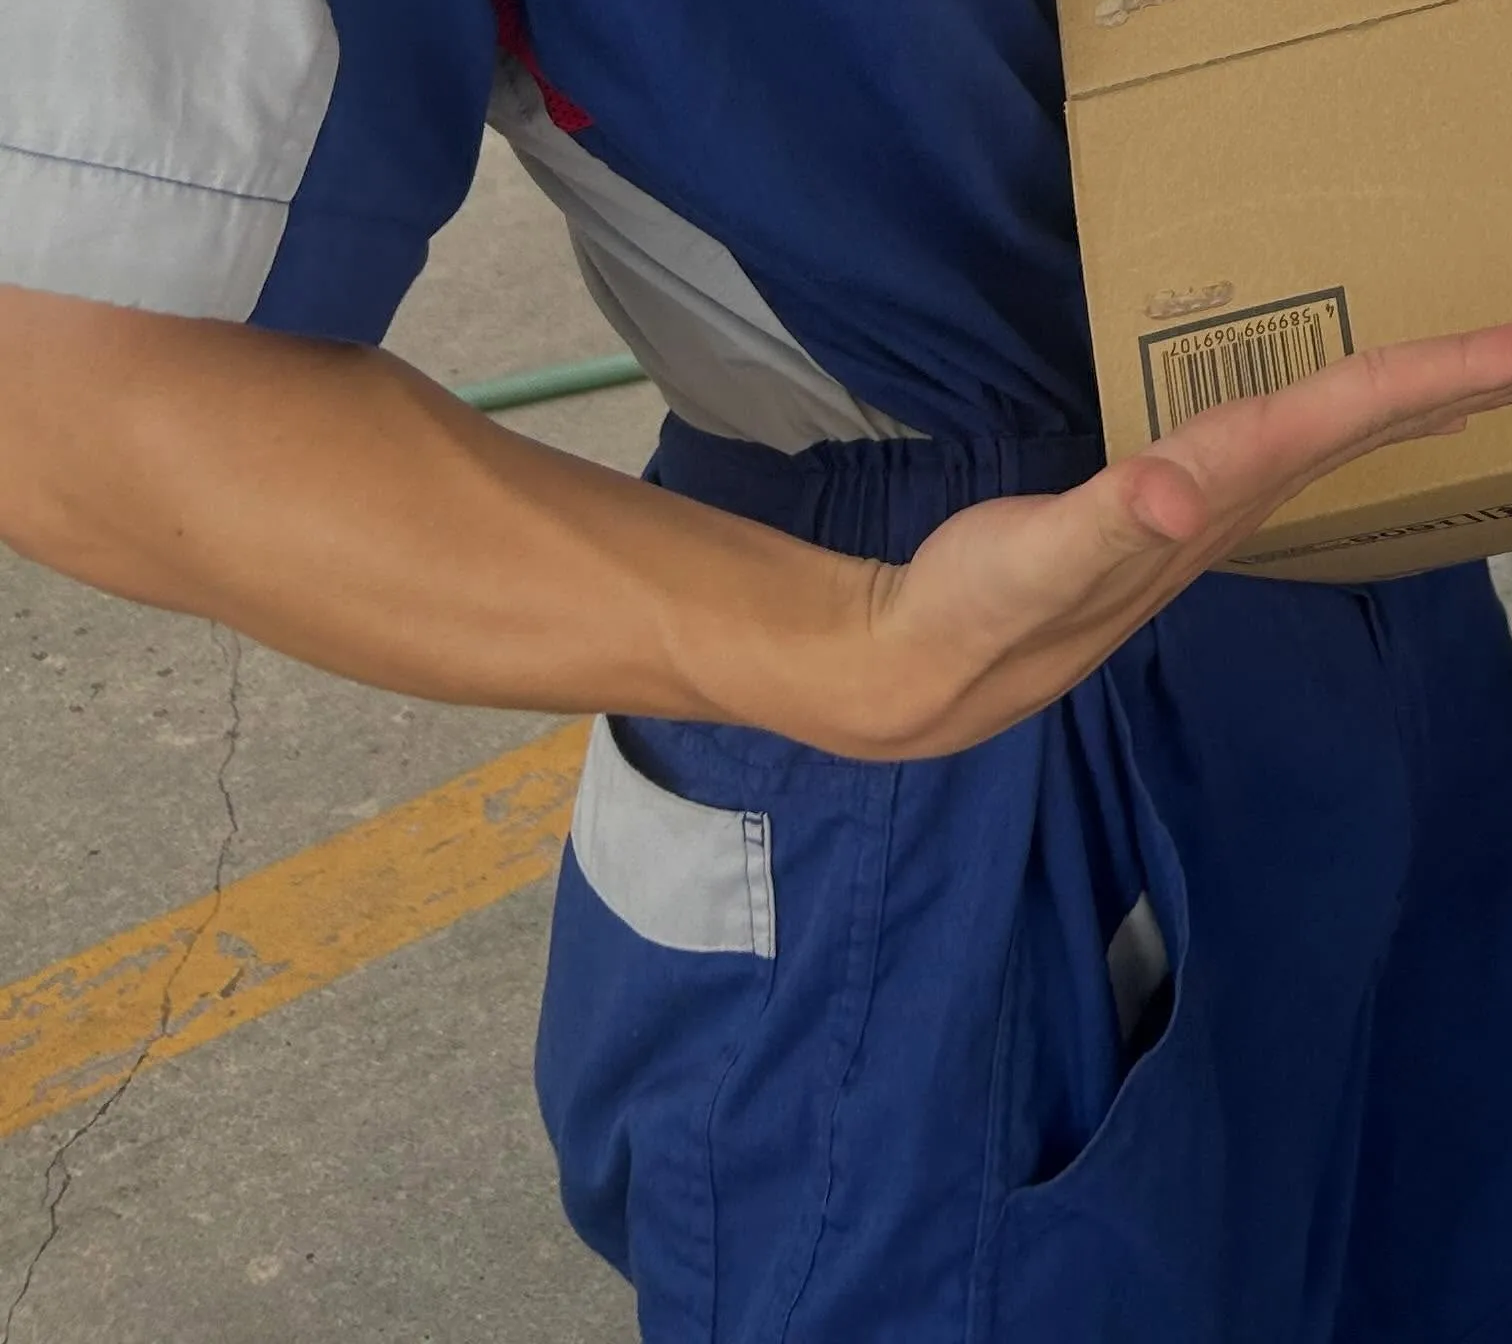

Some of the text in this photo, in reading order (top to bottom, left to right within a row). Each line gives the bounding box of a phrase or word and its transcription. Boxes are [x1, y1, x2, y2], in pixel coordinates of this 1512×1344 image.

[1166, 302, 1335, 357] 4 589999 069107
